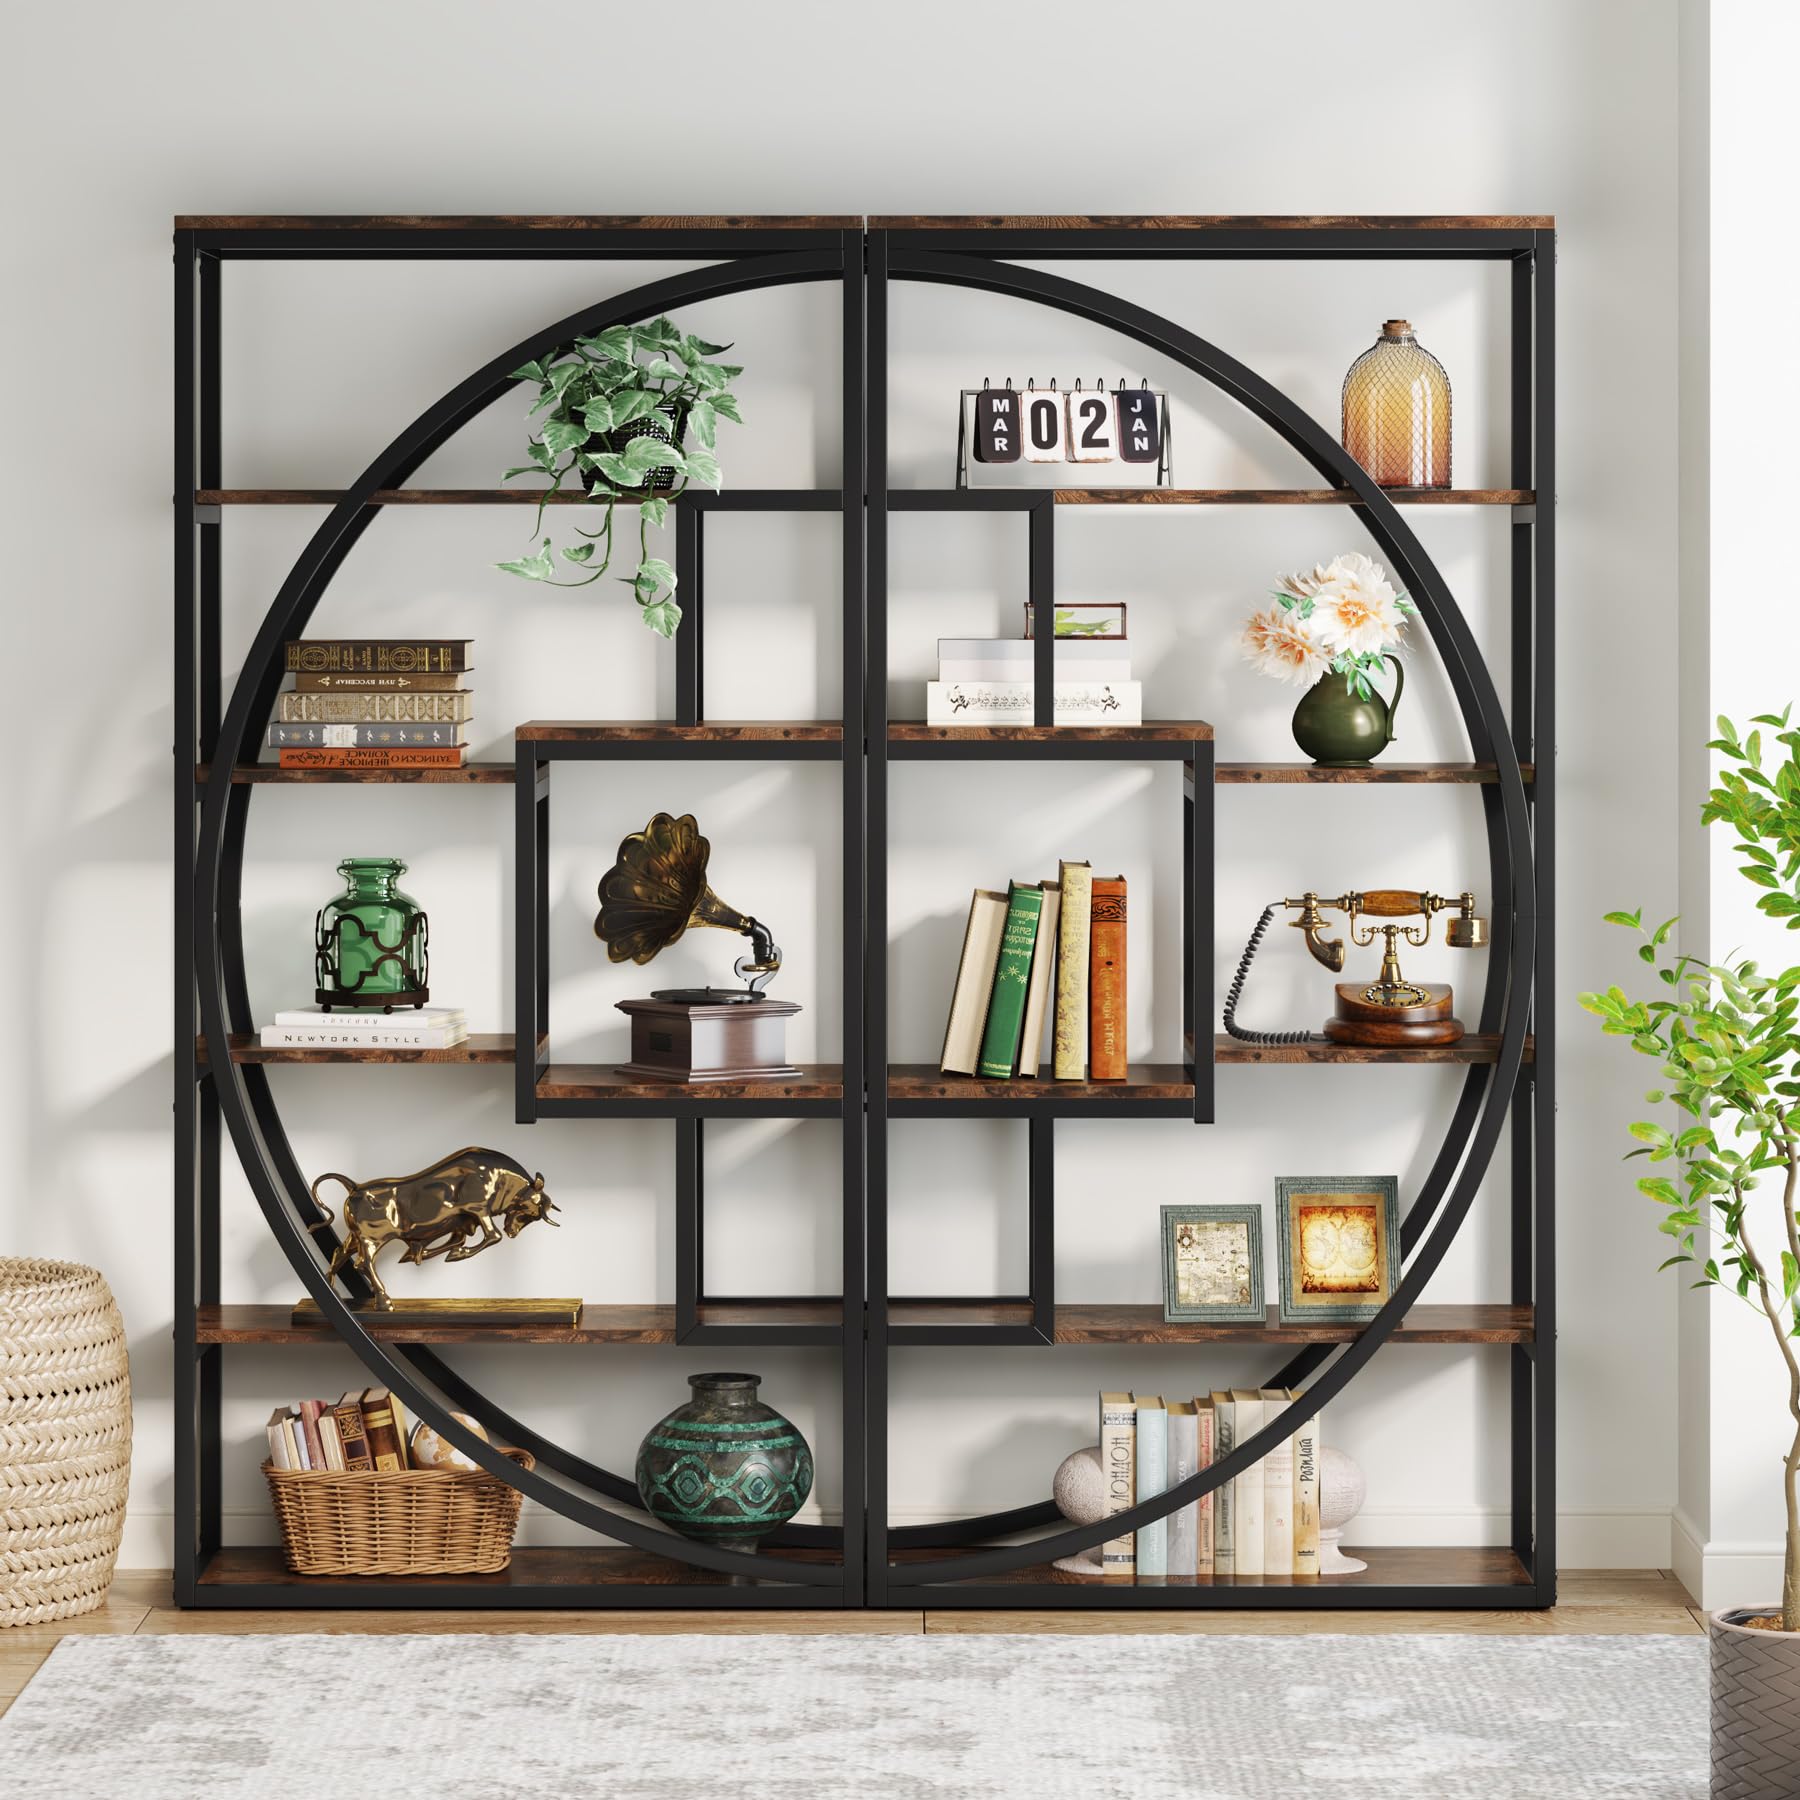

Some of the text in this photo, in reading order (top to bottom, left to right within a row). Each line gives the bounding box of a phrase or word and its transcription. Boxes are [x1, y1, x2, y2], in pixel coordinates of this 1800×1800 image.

[992, 399, 1010, 451] MAR
[1130, 399, 1149, 451] JAN
[1110, 1437, 1131, 1499] ЛОНДОН
